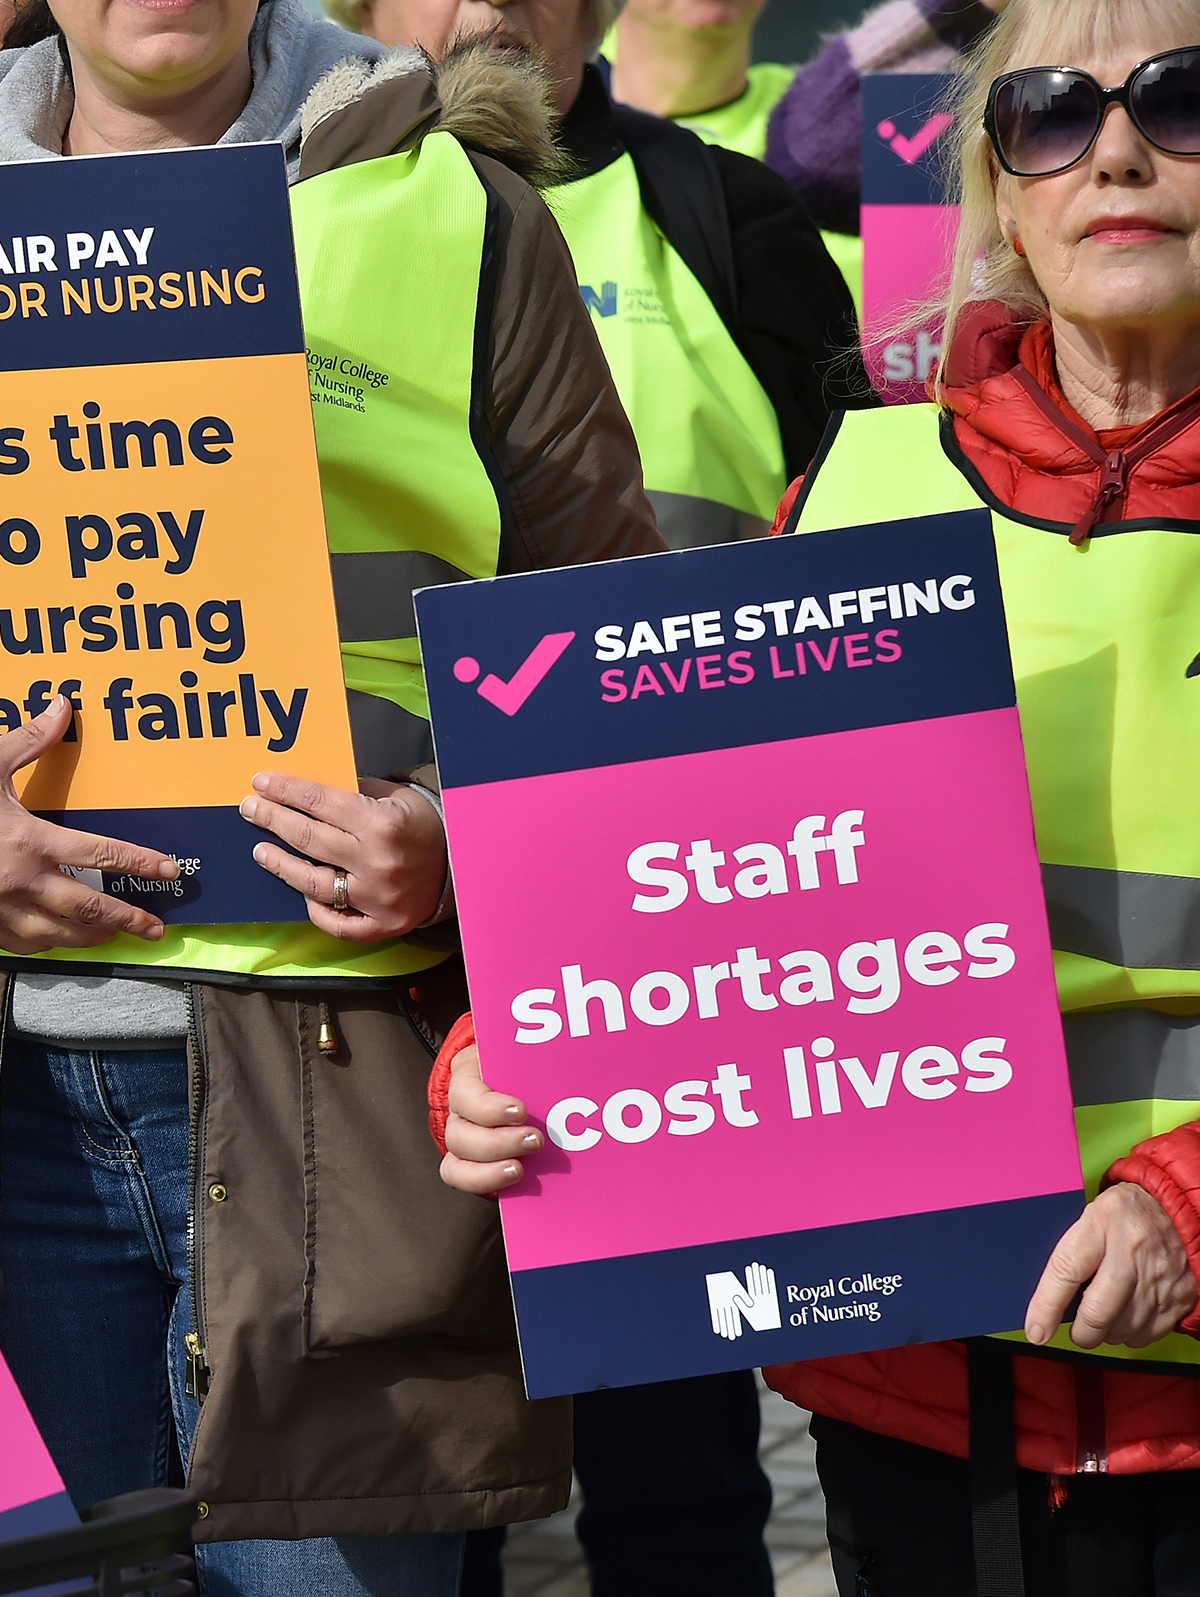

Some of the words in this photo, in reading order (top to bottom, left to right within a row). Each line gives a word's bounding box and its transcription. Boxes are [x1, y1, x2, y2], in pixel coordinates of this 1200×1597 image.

[67, 228, 154, 269] PAY
[62, 267, 265, 315] NURSING
[314, 372, 364, 402] Nursing
[340, 359, 389, 388] College
[323, 393, 366, 413] Midlands
[49, 402, 233, 471] time
[65, 510, 204, 578] pay
[595, 611, 724, 661] SAFE
[735, 575, 975, 640] STAFFING
[601, 651, 754, 702] SAVES
[770, 630, 902, 678] LIVES
[104, 671, 308, 752] fairly
[112, 877, 125, 892] of
[130, 878, 184, 897] Nursing
[627, 810, 865, 912] Staff
[511, 923, 1015, 1043] shortages
[546, 1064, 759, 1151] cost
[784, 1037, 1012, 1119] lives
[787, 1279, 834, 1306] Royal
[838, 1273, 902, 1295] College
[790, 1307, 808, 1326] of
[813, 1301, 881, 1323] Nursing
